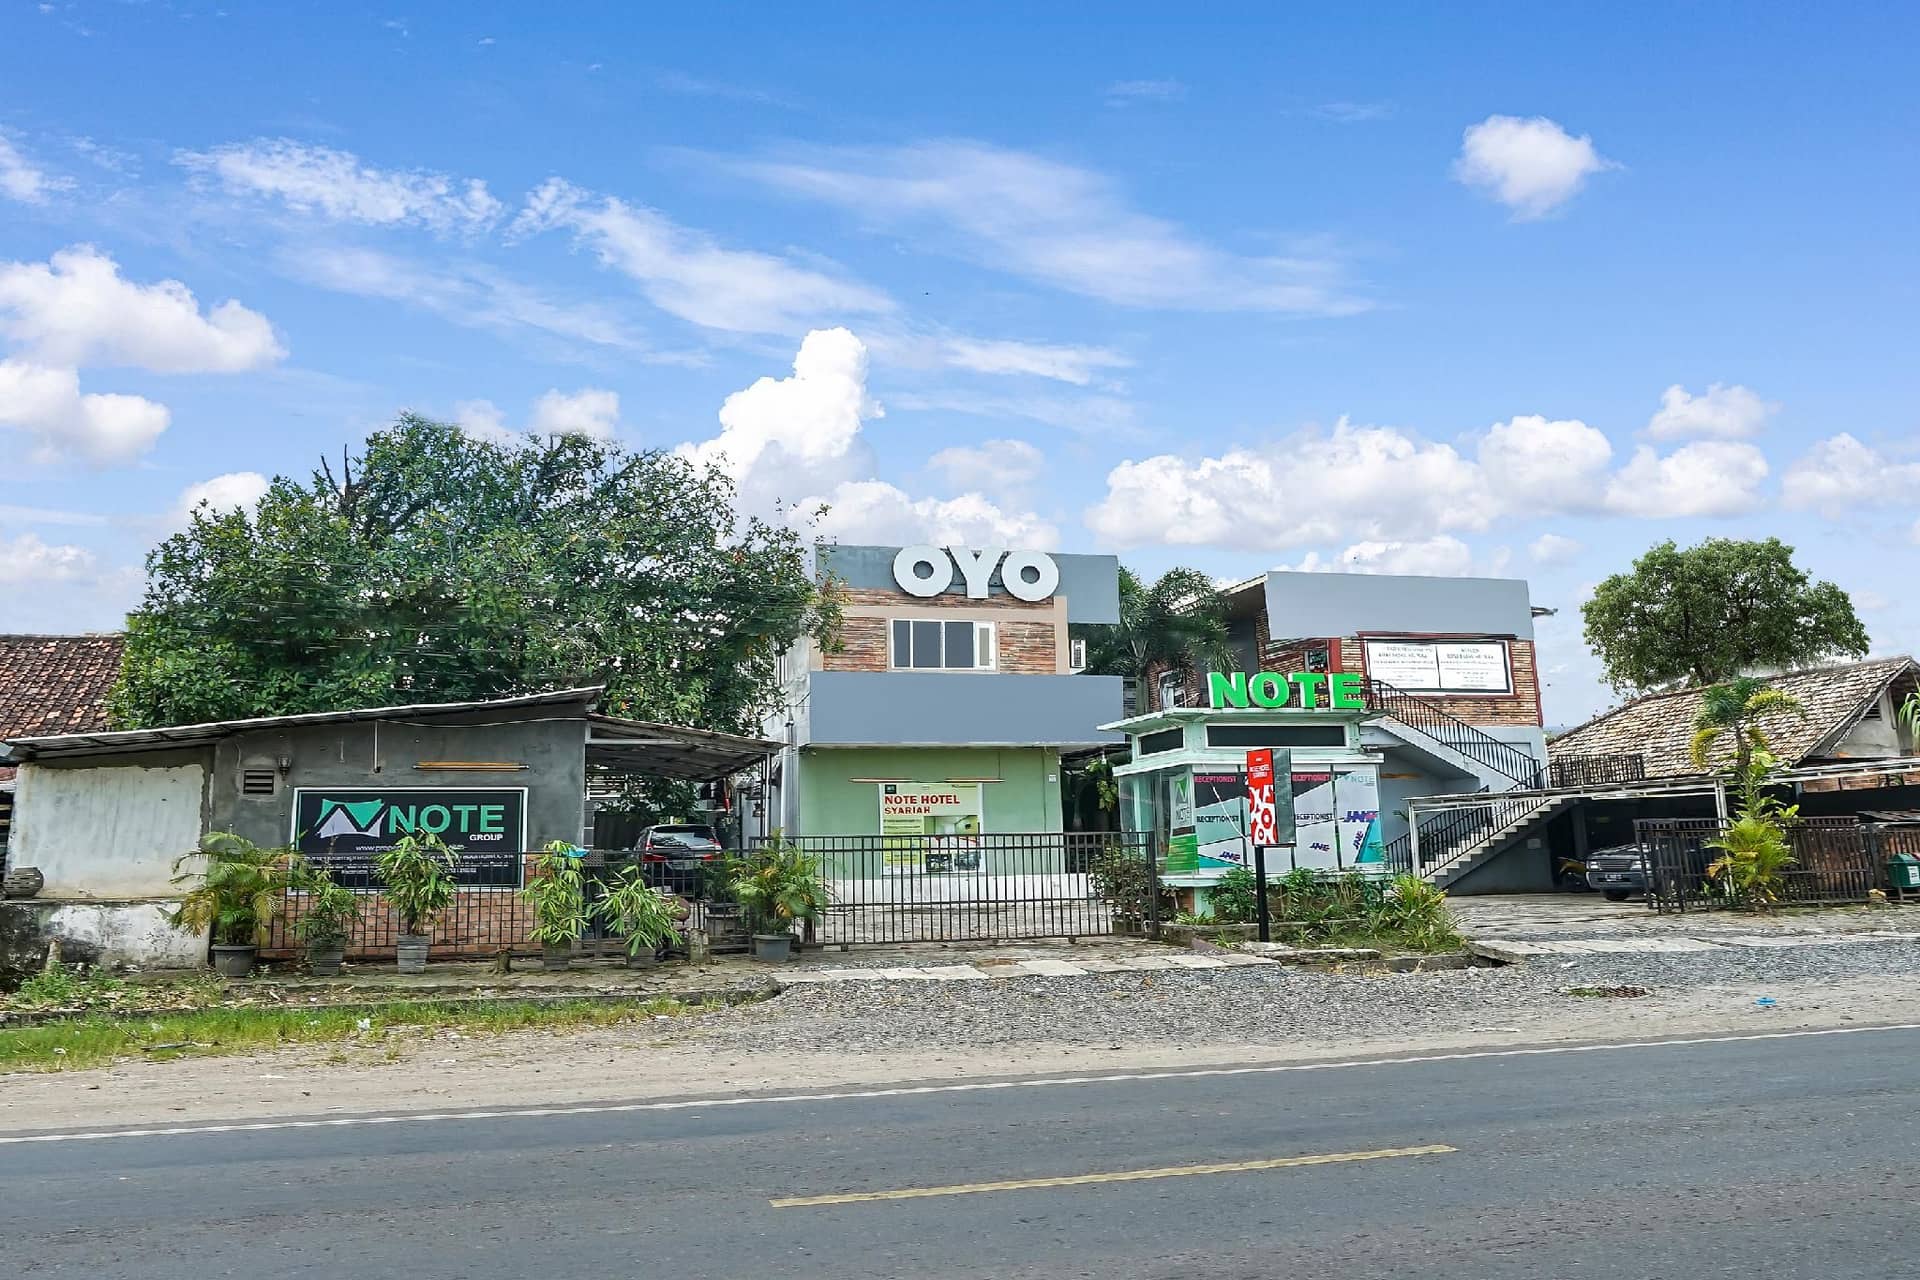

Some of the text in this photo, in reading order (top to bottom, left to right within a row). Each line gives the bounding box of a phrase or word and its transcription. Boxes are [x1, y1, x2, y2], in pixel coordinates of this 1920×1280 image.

[891, 544, 1060, 602] OYO
[1207, 671, 1365, 709] NOTE
[1195, 775, 1238, 783] RECEPTIONIST
[885, 794, 961, 805] NOTE HOTEL
[884, 806, 931, 815] SYARIAH
[388, 804, 505, 834] NOTE
[1196, 815, 1240, 823] RECEPTIONIST
[469, 833, 504, 841] GROUP
